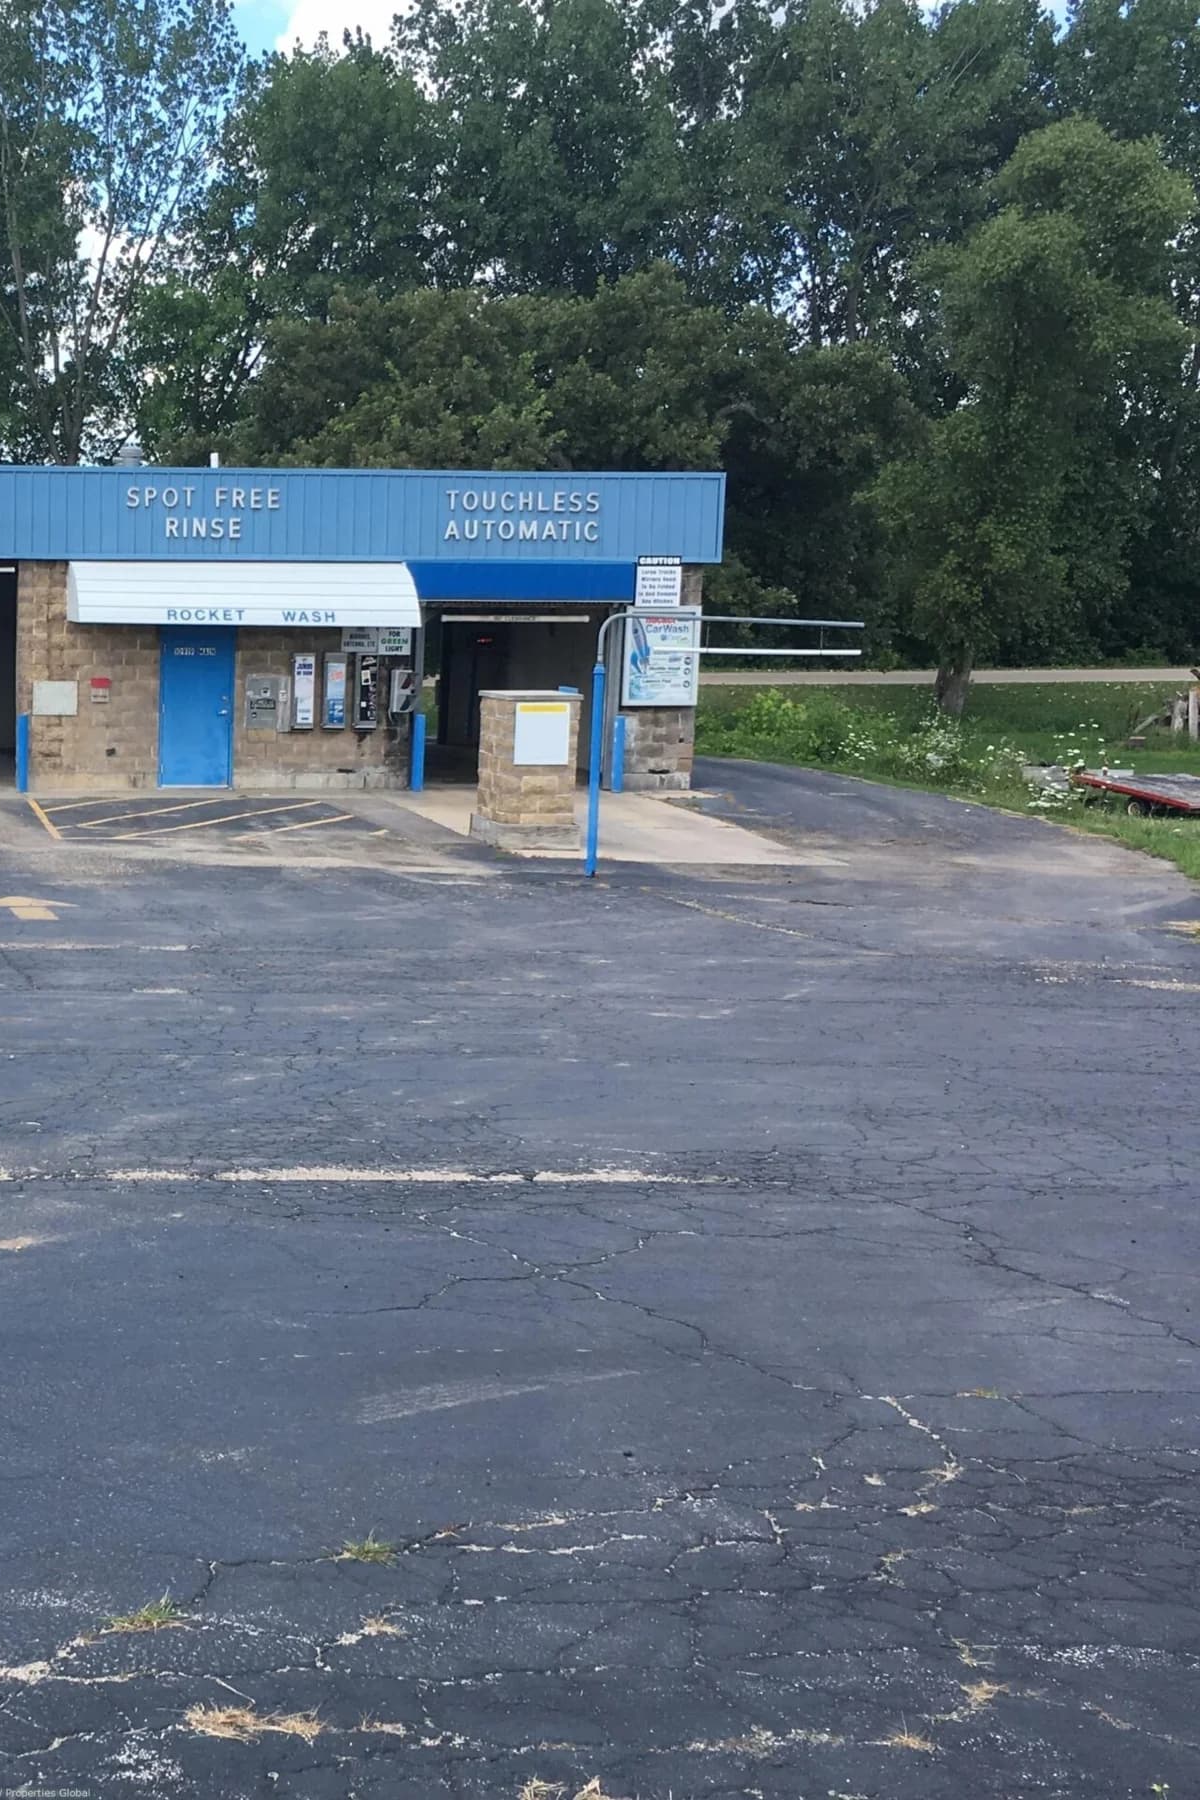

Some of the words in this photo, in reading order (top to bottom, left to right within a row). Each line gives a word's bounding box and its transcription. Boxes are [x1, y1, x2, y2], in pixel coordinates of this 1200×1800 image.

[126, 486, 196, 508] SPOT
[215, 487, 280, 509] FREE
[446, 490, 600, 513] TOUCHLESS
[165, 517, 241, 539] RINSE
[444, 519, 599, 541] AUTOMATIC
[639, 557, 680, 565] CAUTION
[167, 609, 245, 621] ROCKET
[282, 611, 336, 623] WASH
[645, 624, 689, 633] CarWash
